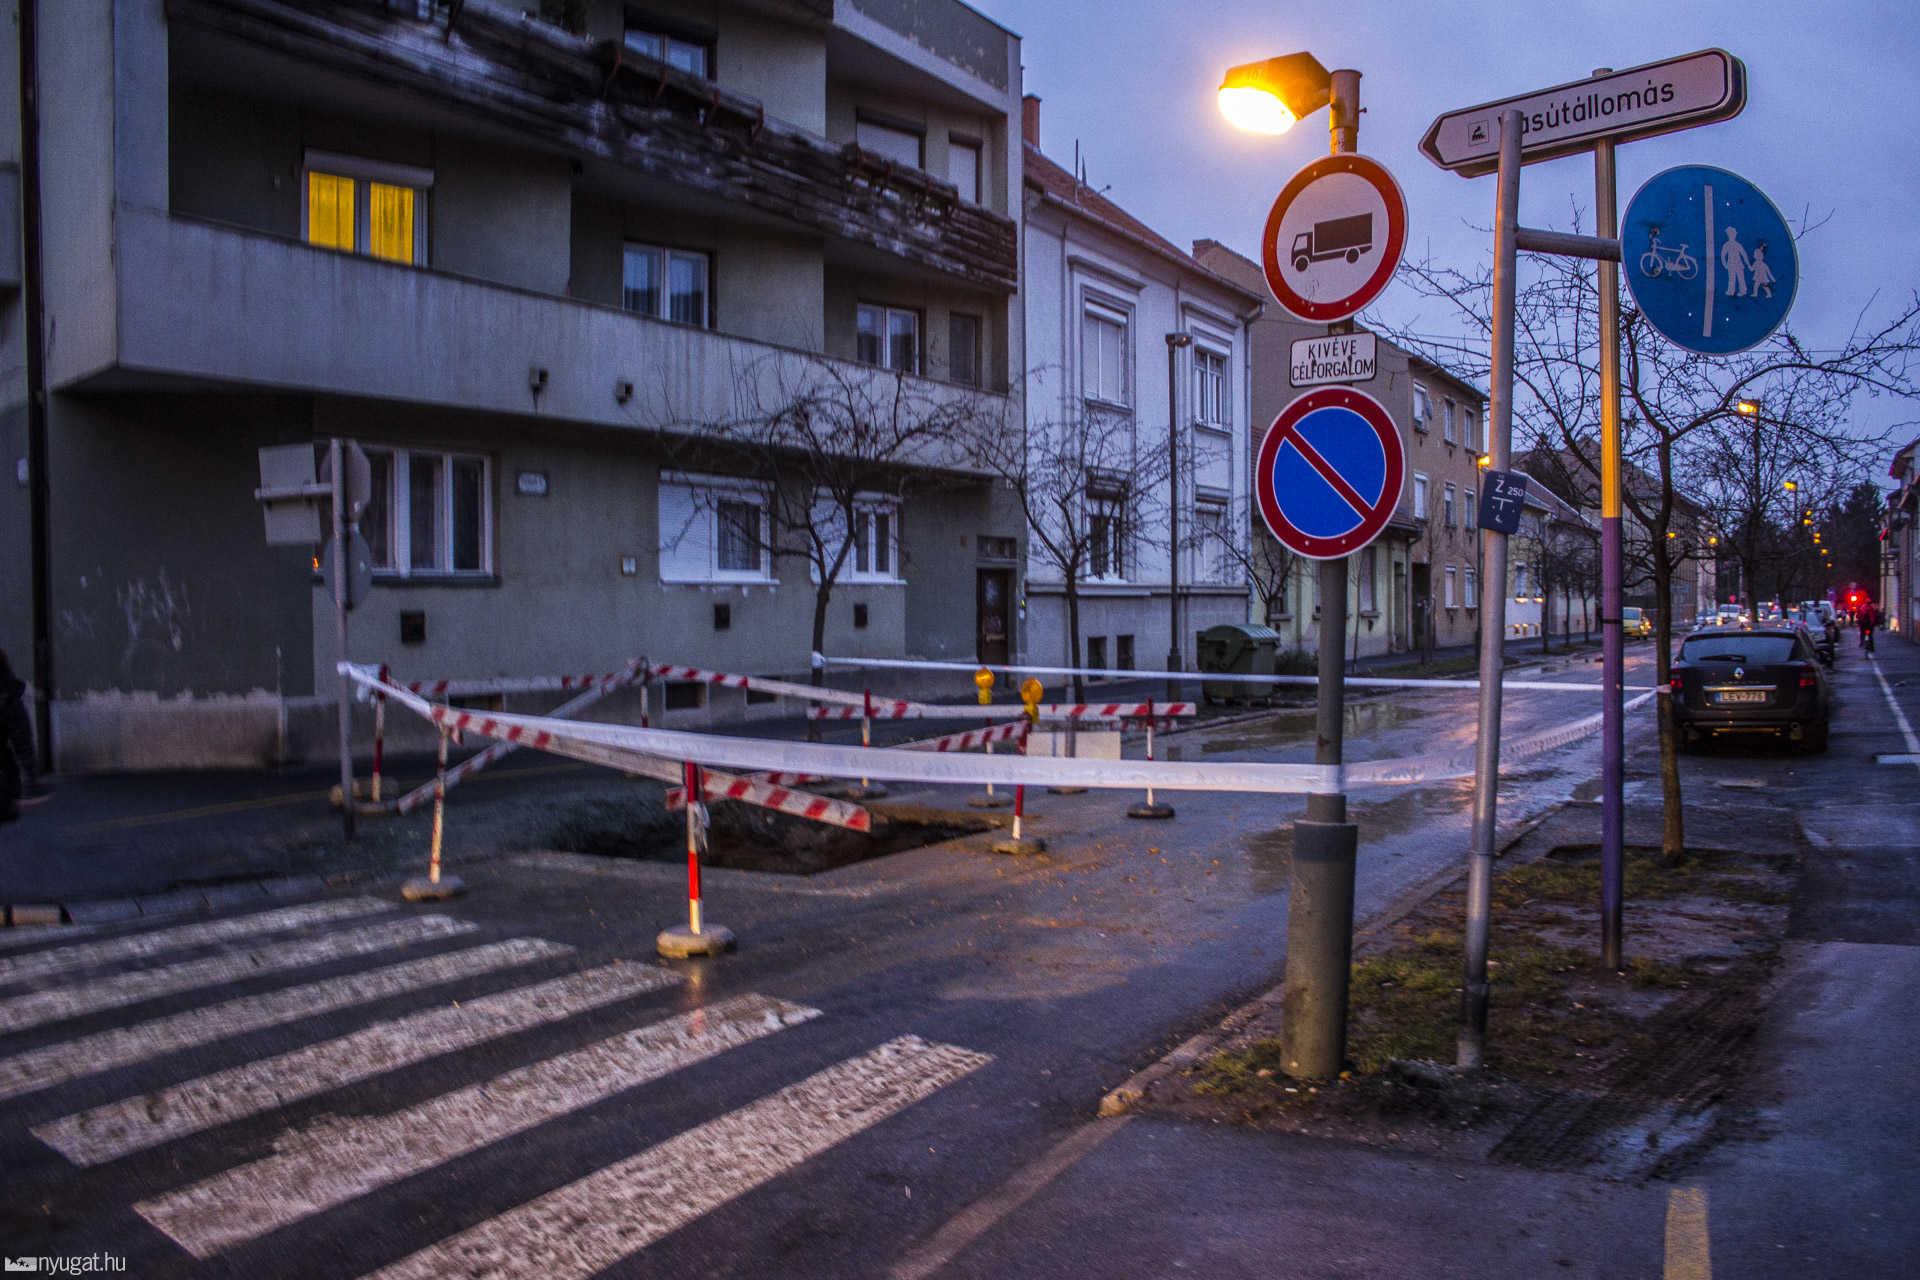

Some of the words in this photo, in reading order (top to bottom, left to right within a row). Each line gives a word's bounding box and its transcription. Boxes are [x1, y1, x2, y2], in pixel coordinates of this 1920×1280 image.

[1498, 80, 1675, 134] asútállomás
[1308, 338, 1357, 360] KIVÉVE
[1292, 358, 1374, 381] CÉLFORGALOM
[1495, 479, 1505, 493] Z
[1507, 486, 1524, 497] 250
